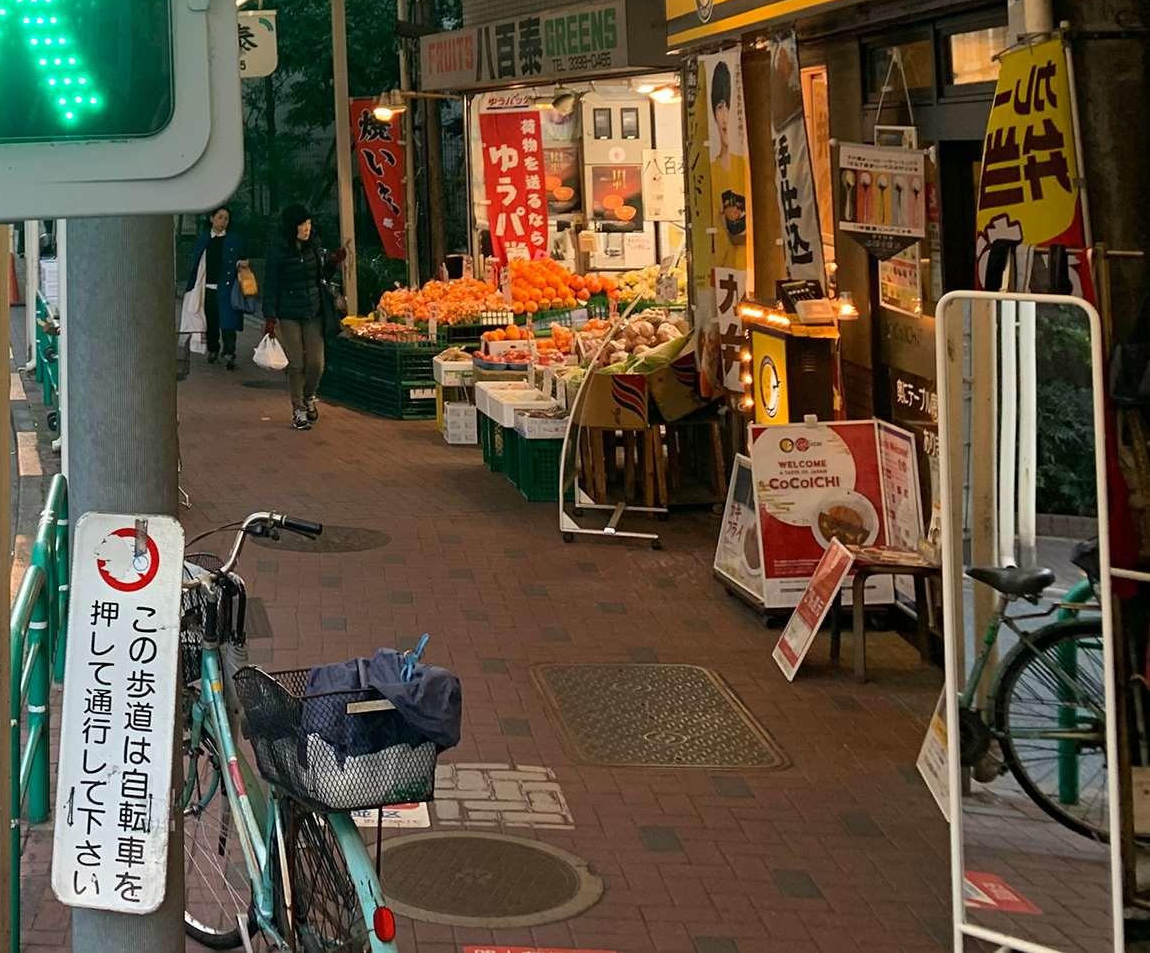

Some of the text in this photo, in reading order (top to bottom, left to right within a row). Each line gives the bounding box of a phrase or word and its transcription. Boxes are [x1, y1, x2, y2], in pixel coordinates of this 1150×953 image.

[428, 35, 474, 75] FRUITS
[544, 7, 617, 57] GREENS
[552, 59, 566, 72] TEL
[358, 108, 401, 216] 焼いも
[520, 118, 546, 247] 荷物を送るなら
[768, 476, 840, 490] CoCoICHI
[778, 460, 827, 469] WELCOME
[73, 600, 120, 897] 押して通行して下さい
[114, 606, 158, 904] この歩道は自転車を
